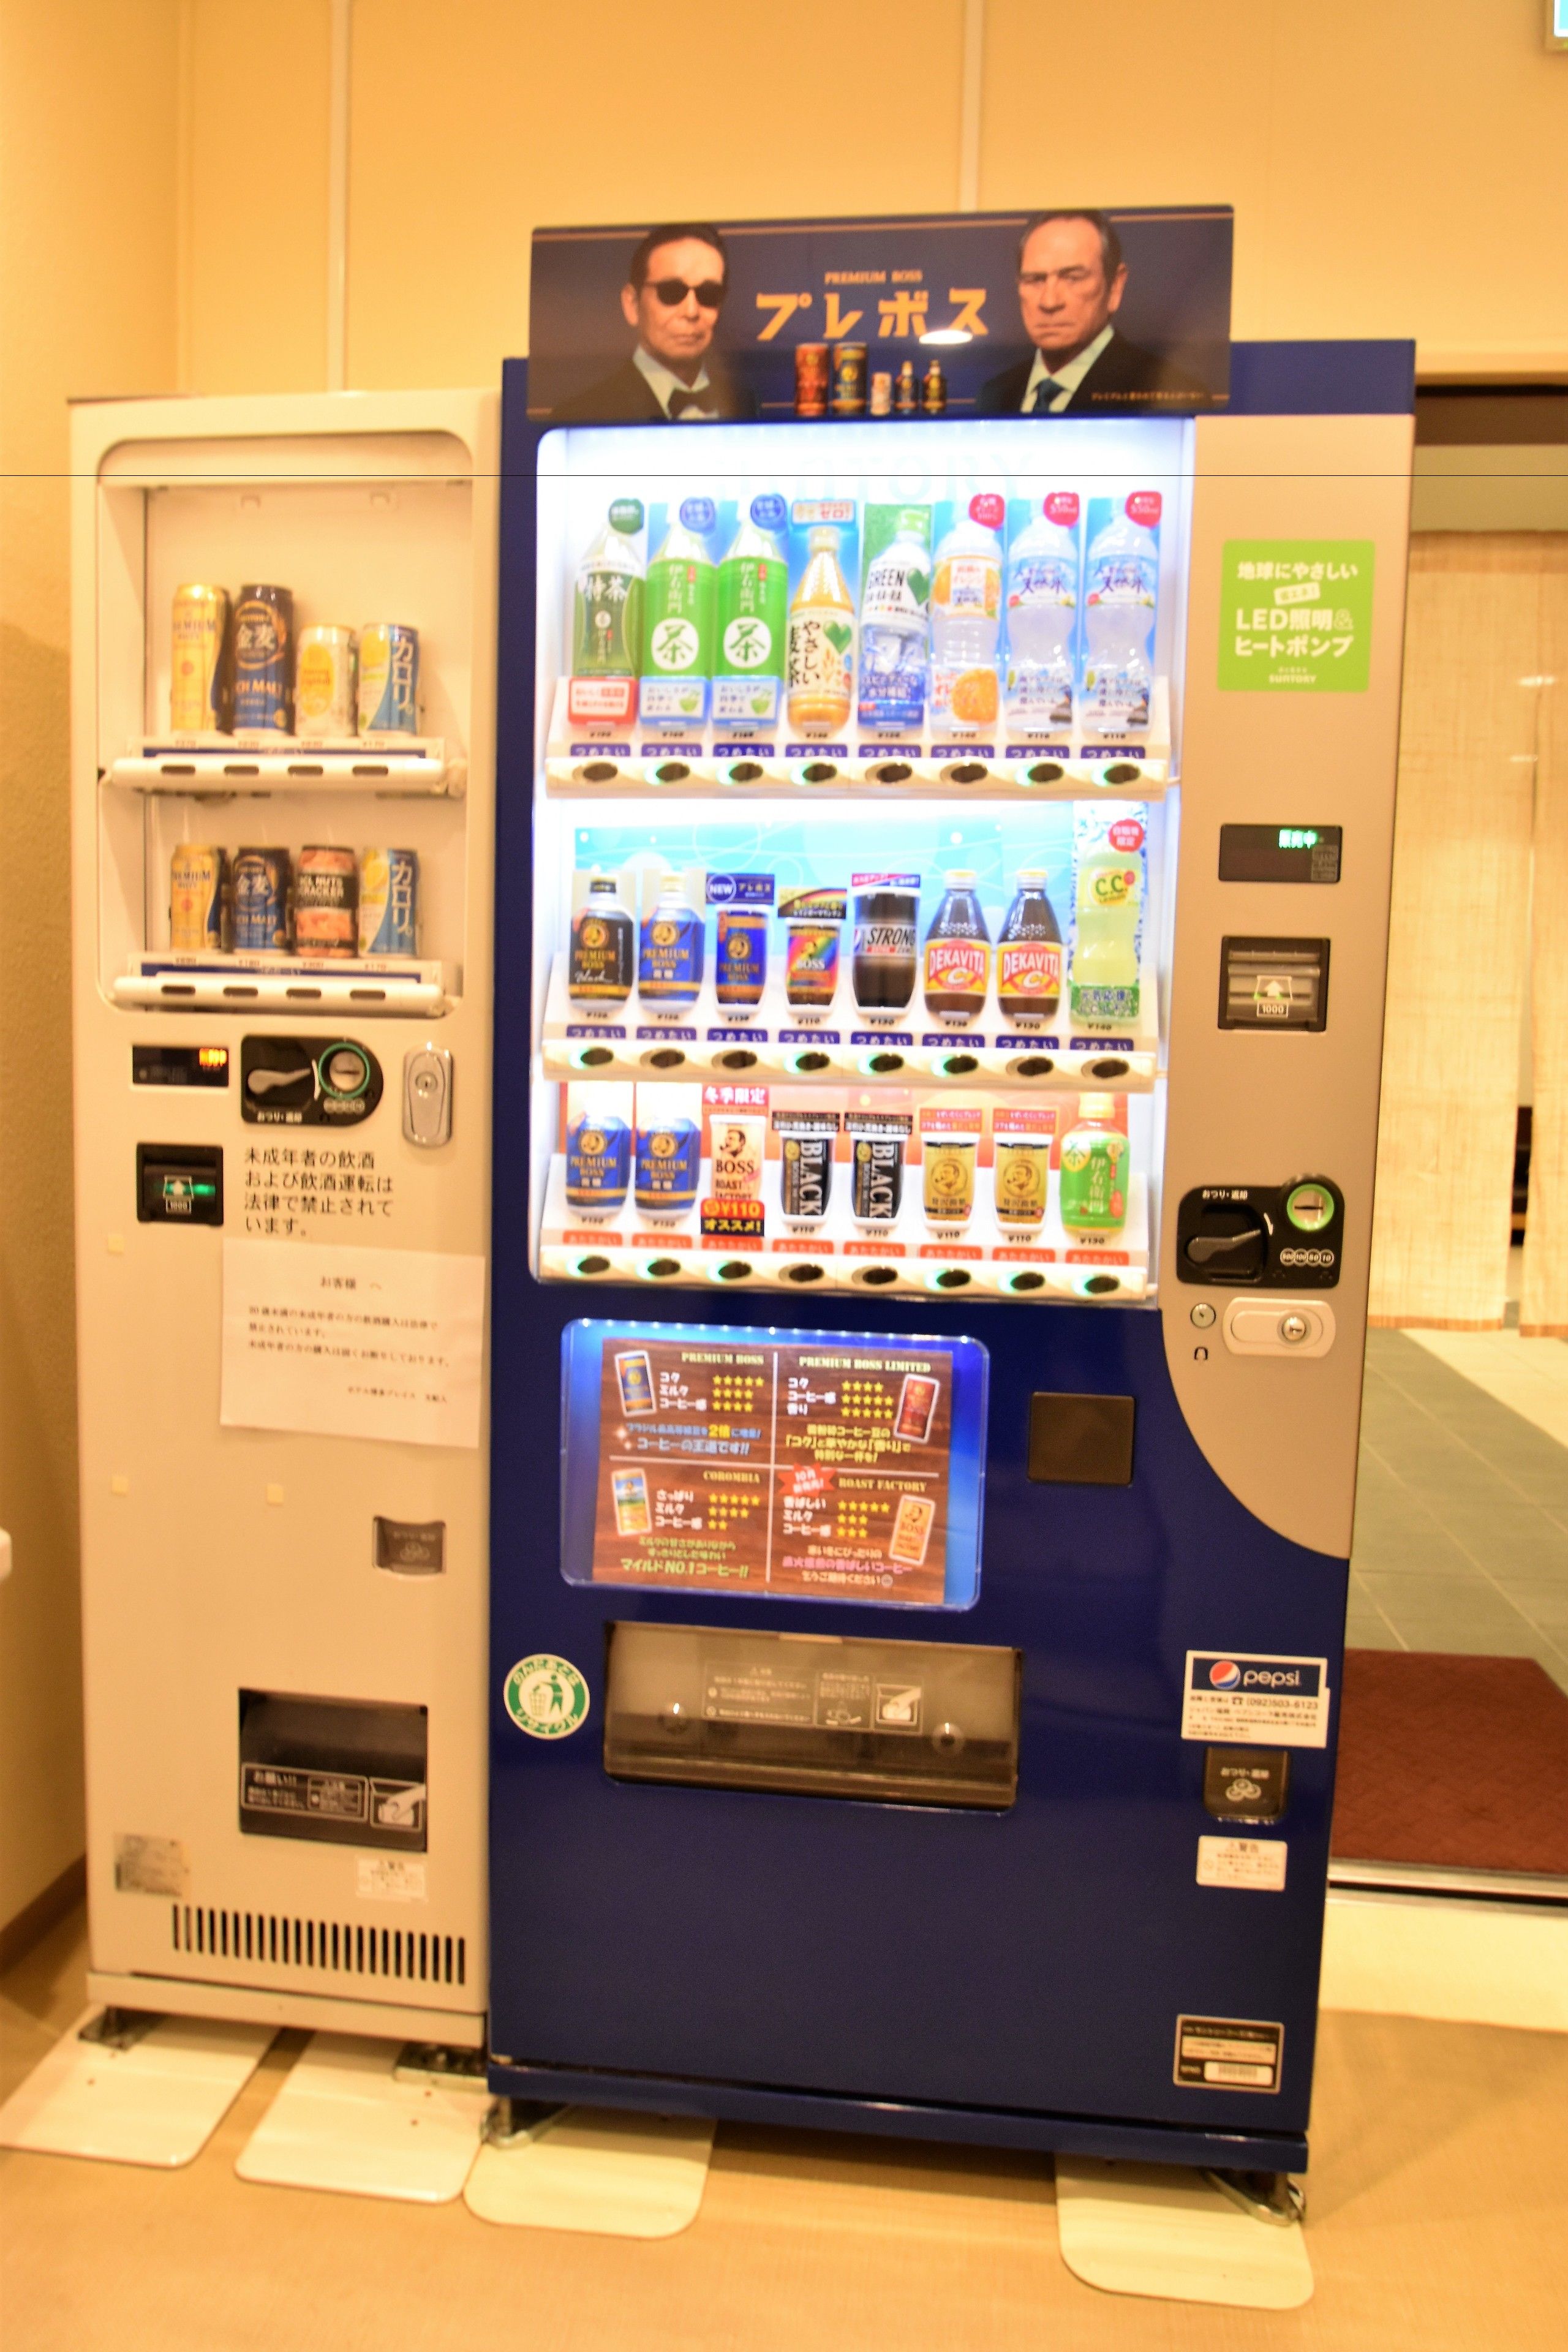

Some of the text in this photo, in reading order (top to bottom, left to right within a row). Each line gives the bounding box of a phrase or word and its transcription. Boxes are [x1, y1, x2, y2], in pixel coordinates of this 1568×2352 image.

[824, 270, 922, 285] PREMIUM BOSS
[756, 287, 989, 341] プレボス
[1237, 561, 1359, 580] 地球にやさしい
[1235, 608, 1354, 631] LED照明&
[1235, 633, 1354, 659] ヒートポンプ
[1268, 674, 1317, 684] SUNTORY
[1262, 1004, 1284, 1014] 1000
[704, 1086, 766, 1105] 冬季限定
[246, 1147, 375, 1169] 未成年者の飲酒
[715, 1159, 755, 1174] BOSS
[245, 1169, 393, 1193] および飲酒運転は
[799, 1139, 824, 1216] BLACK
[870, 1142, 895, 1219] BLACK
[1202, 1189, 1248, 1200] おつり・返却
[244, 1193, 393, 1217] 法律で禁止されて
[722, 1202, 761, 1214] ¥110
[246, 1216, 306, 1236] います。
[704, 1219, 763, 1232] オススメ!
[320, 1276, 357, 1291] お客様
[680, 1351, 764, 1365] PREMIUM BOSS
[799, 1355, 932, 1373] PREMIUM BOSS LIMITED
[659, 1371, 680, 1383] コク
[787, 1376, 809, 1390] コク
[659, 1385, 689, 1396] ミルク
[703, 1470, 761, 1484] COROMBIA
[838, 1477, 927, 1493] ROAST FACTORY
[655, 1502, 685, 1515] ミルク
[783, 1495, 827, 1510] 香ばしい
[783, 1509, 813, 1522] ミルク
[620, 1557, 750, 1579] マイルドNO.1コーヒー!!
[1243, 1669, 1301, 1689] pepsi
